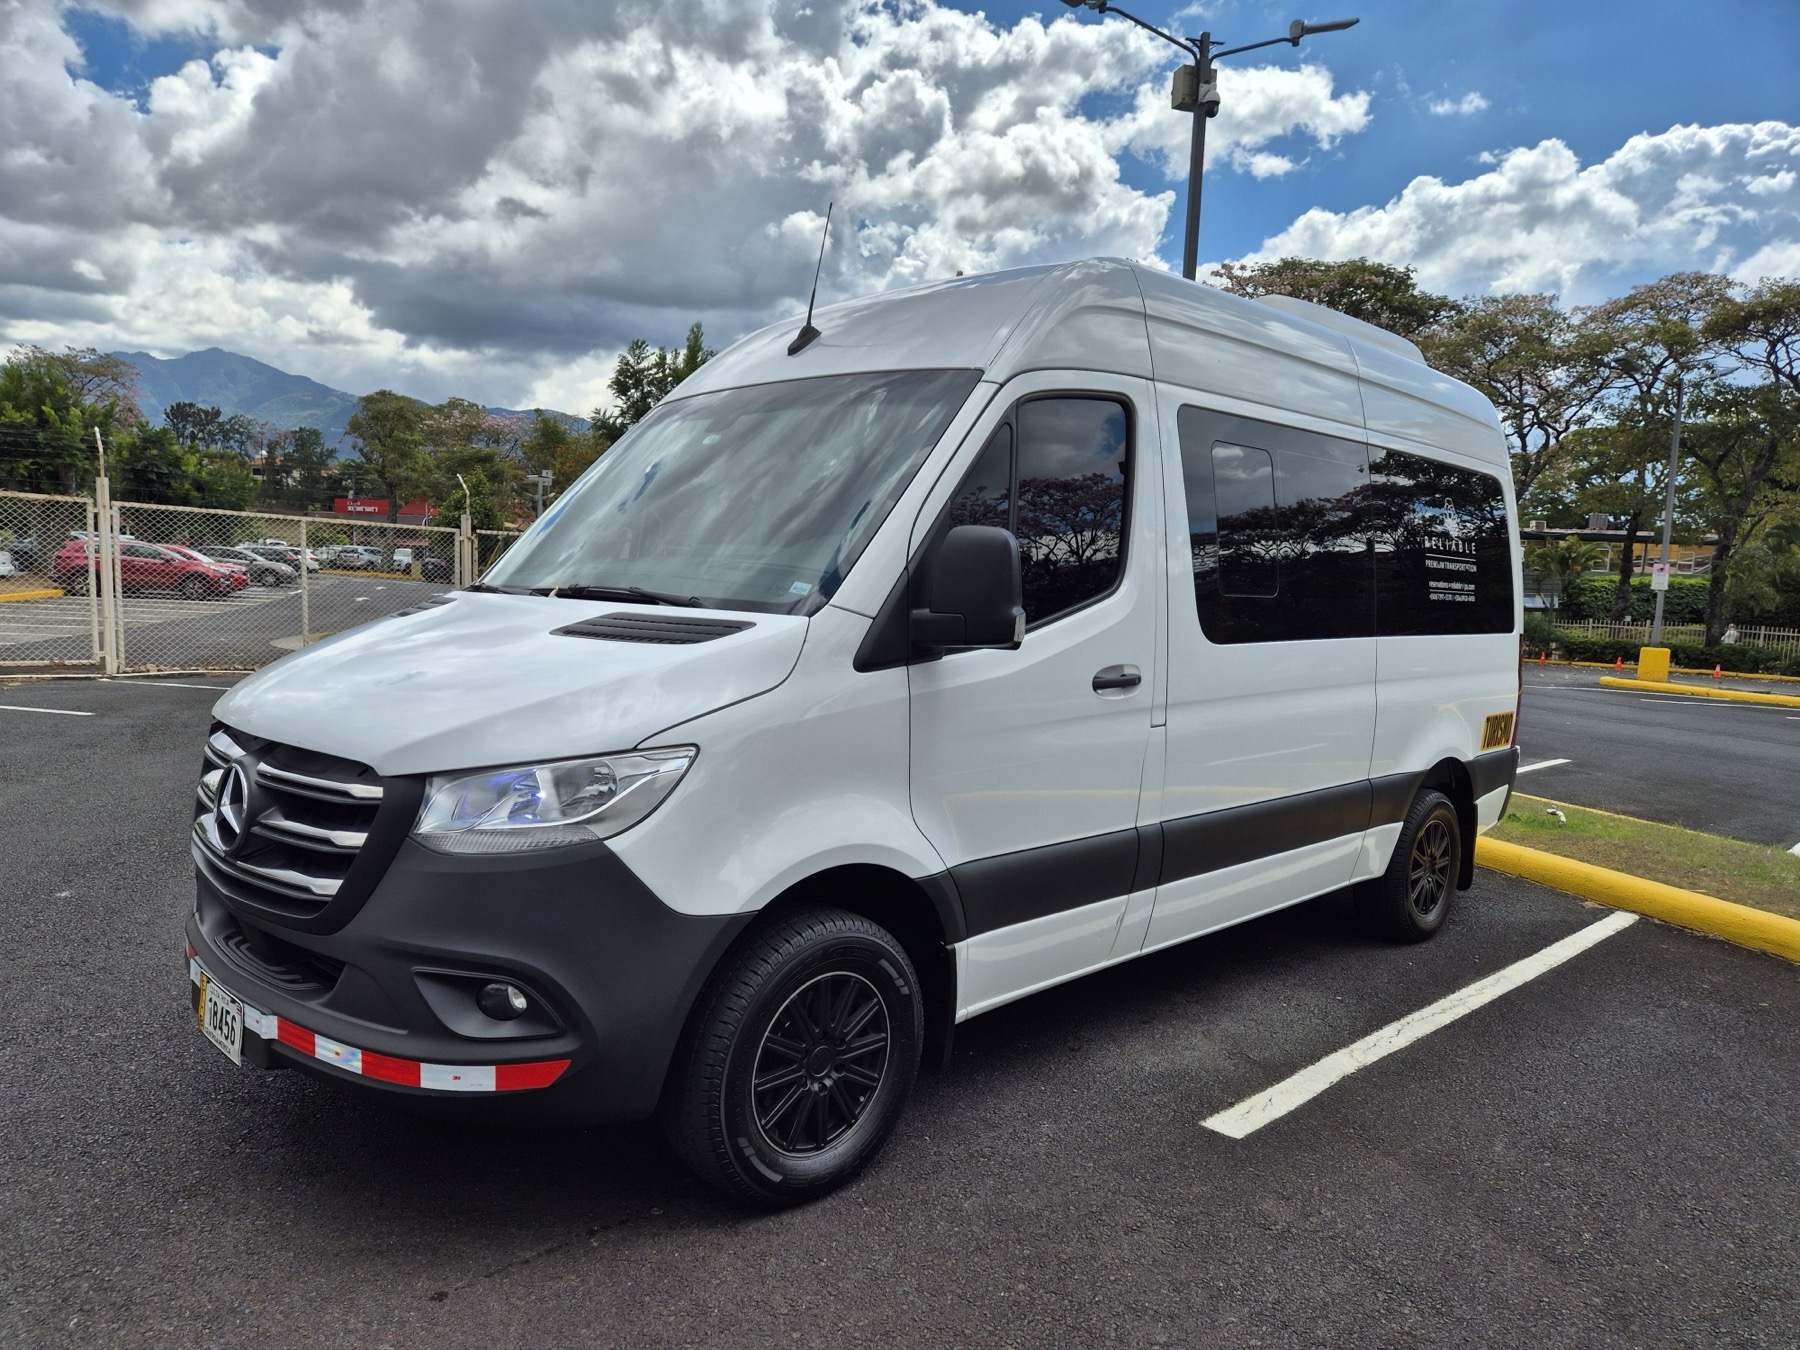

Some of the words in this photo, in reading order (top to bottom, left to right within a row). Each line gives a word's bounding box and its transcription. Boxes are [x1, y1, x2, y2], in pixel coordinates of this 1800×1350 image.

[1424, 536, 1476, 554] RELIABLE
[1425, 559, 1445, 569] PREMIUM
[1482, 713, 1513, 748] TURISMO
[209, 997, 236, 1046] 18456
